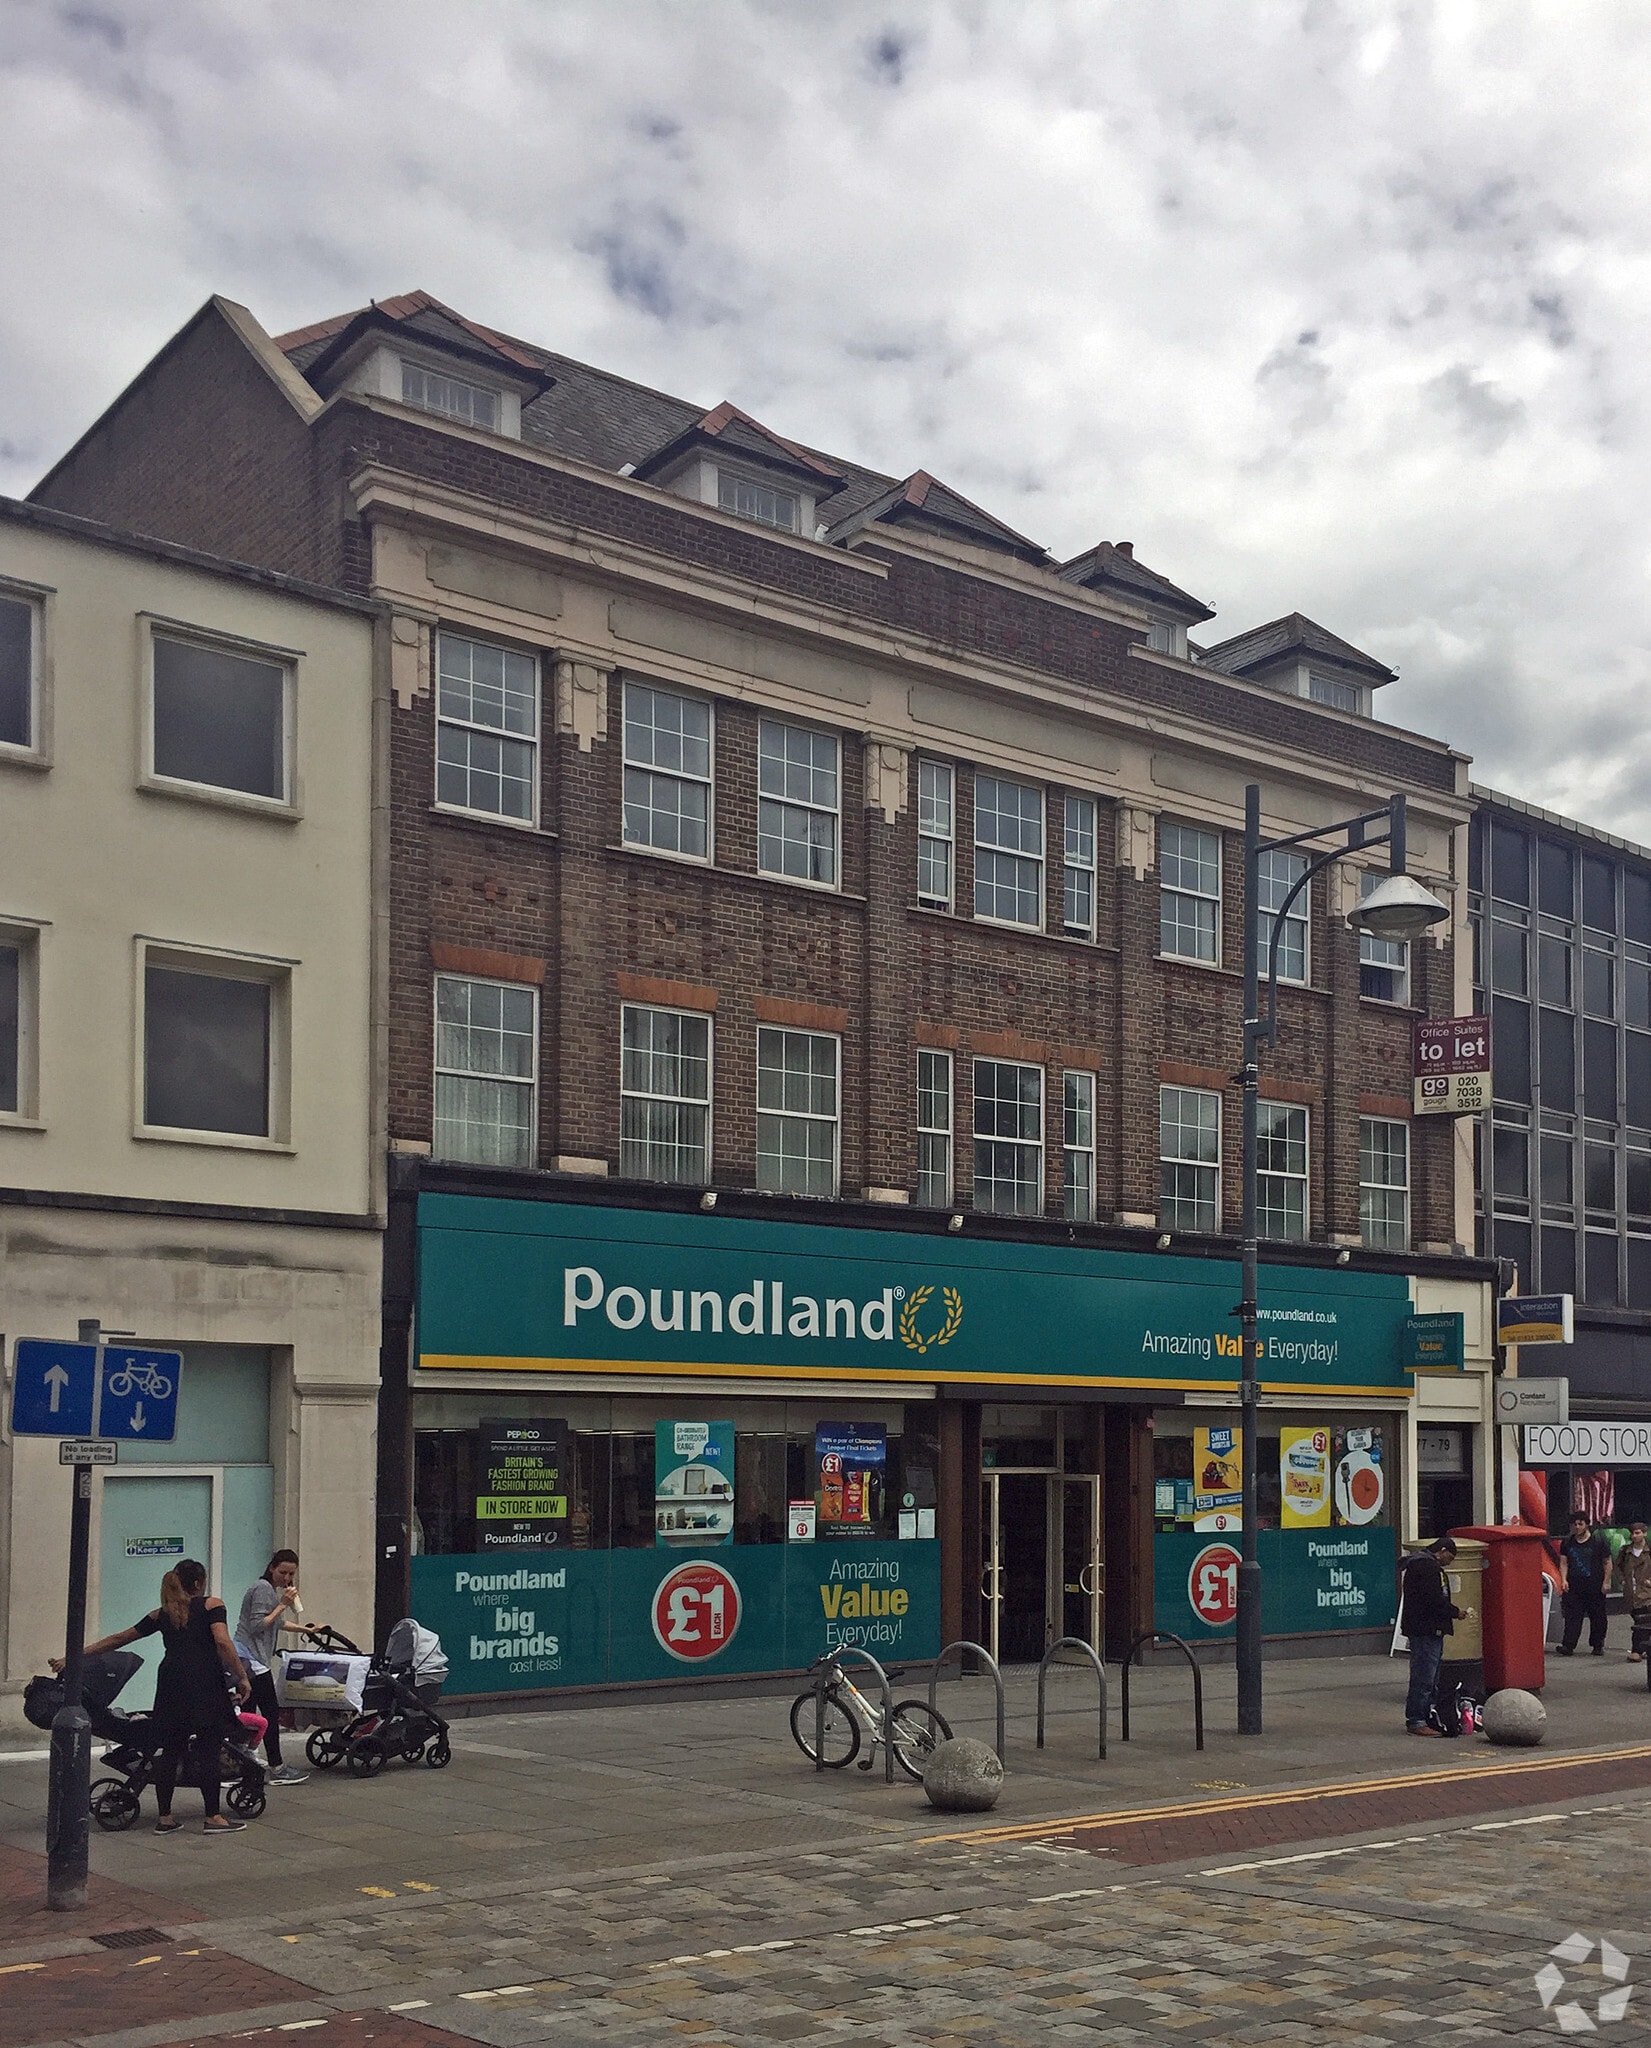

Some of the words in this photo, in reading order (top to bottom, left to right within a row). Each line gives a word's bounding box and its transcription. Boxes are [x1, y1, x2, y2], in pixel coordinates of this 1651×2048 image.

[1420, 1028, 1450, 1038] Office
[1453, 1025, 1484, 1036] Suites
[1420, 1042, 1443, 1061] to
[1454, 1037, 1485, 1058] let
[1458, 1076, 1479, 1086] 020
[1456, 1087, 1482, 1097] 7038
[1457, 1097, 1482, 1108] 3512
[1256, 1308, 1337, 1323] ww.poundland.co.uk
[1407, 1318, 1455, 1329] Poundland
[1142, 1329, 1211, 1360] Amazing
[1214, 1333, 1264, 1358] Vale
[1268, 1336, 1338, 1364] Everyday!
[676, 1442, 696, 1450] RANGE
[1314, 1435, 1326, 1450] £1
[1439, 1438, 1450, 1451] 79
[1529, 1426, 1593, 1456] FOOD
[1599, 1427, 1651, 1457] STOR
[80, 1445, 112, 1454] loading
[505, 1457, 544, 1468] BRITAIN'S
[825, 1457, 839, 1472] £1
[488, 1468, 521, 1480] FASTEST
[523, 1468, 558, 1480] GROWING
[492, 1480, 526, 1491] FASHION
[528, 1480, 555, 1491] BRAND
[486, 1501, 497, 1515] IN
[499, 1500, 533, 1515] STORE
[535, 1500, 559, 1514] NOW
[797, 1525, 807, 1534] £1
[485, 1533, 542, 1544] Poundland
[137, 1546, 159, 1555] Keep
[1308, 1540, 1369, 1557] Poundland
[829, 1557, 900, 1583] Amazing
[1317, 1558, 1338, 1567] where
[456, 1568, 566, 1592] Poundland
[1330, 1567, 1352, 1590] big
[1199, 1563, 1237, 1610] £1
[473, 1592, 510, 1606] where
[820, 1583, 909, 1619] Value
[1317, 1586, 1366, 1607] brands
[667, 1584, 725, 1642] £1
[1338, 1607, 1352, 1617] cost
[495, 1606, 535, 1636] big
[714, 1612, 722, 1635] EACH
[826, 1619, 902, 1647] Everyday!
[470, 1631, 559, 1661] brands
[509, 1659, 534, 1673] cost
[536, 1656, 562, 1671] less!
